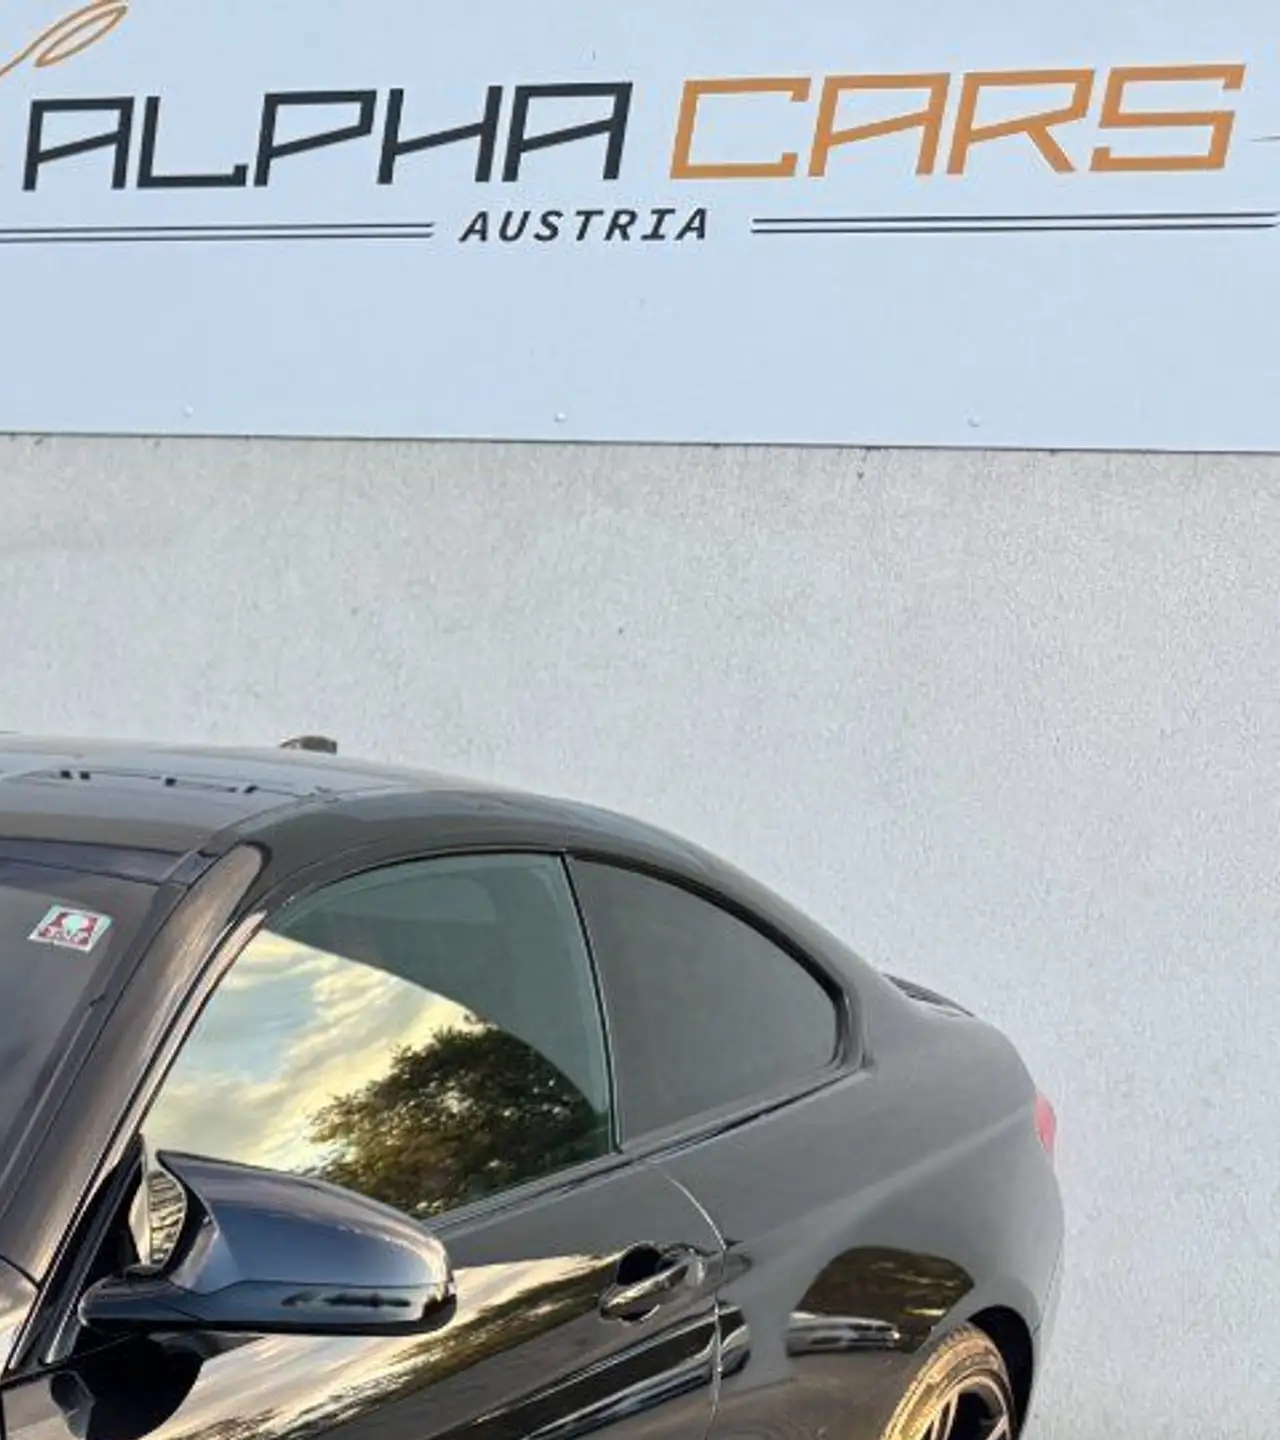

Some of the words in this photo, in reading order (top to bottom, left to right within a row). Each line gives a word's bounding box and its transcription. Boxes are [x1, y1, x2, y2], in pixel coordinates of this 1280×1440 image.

[22, 81, 633, 191] ALPHA
[669, 63, 1246, 180] CARS
[458, 207, 707, 243] AUSTRIA
